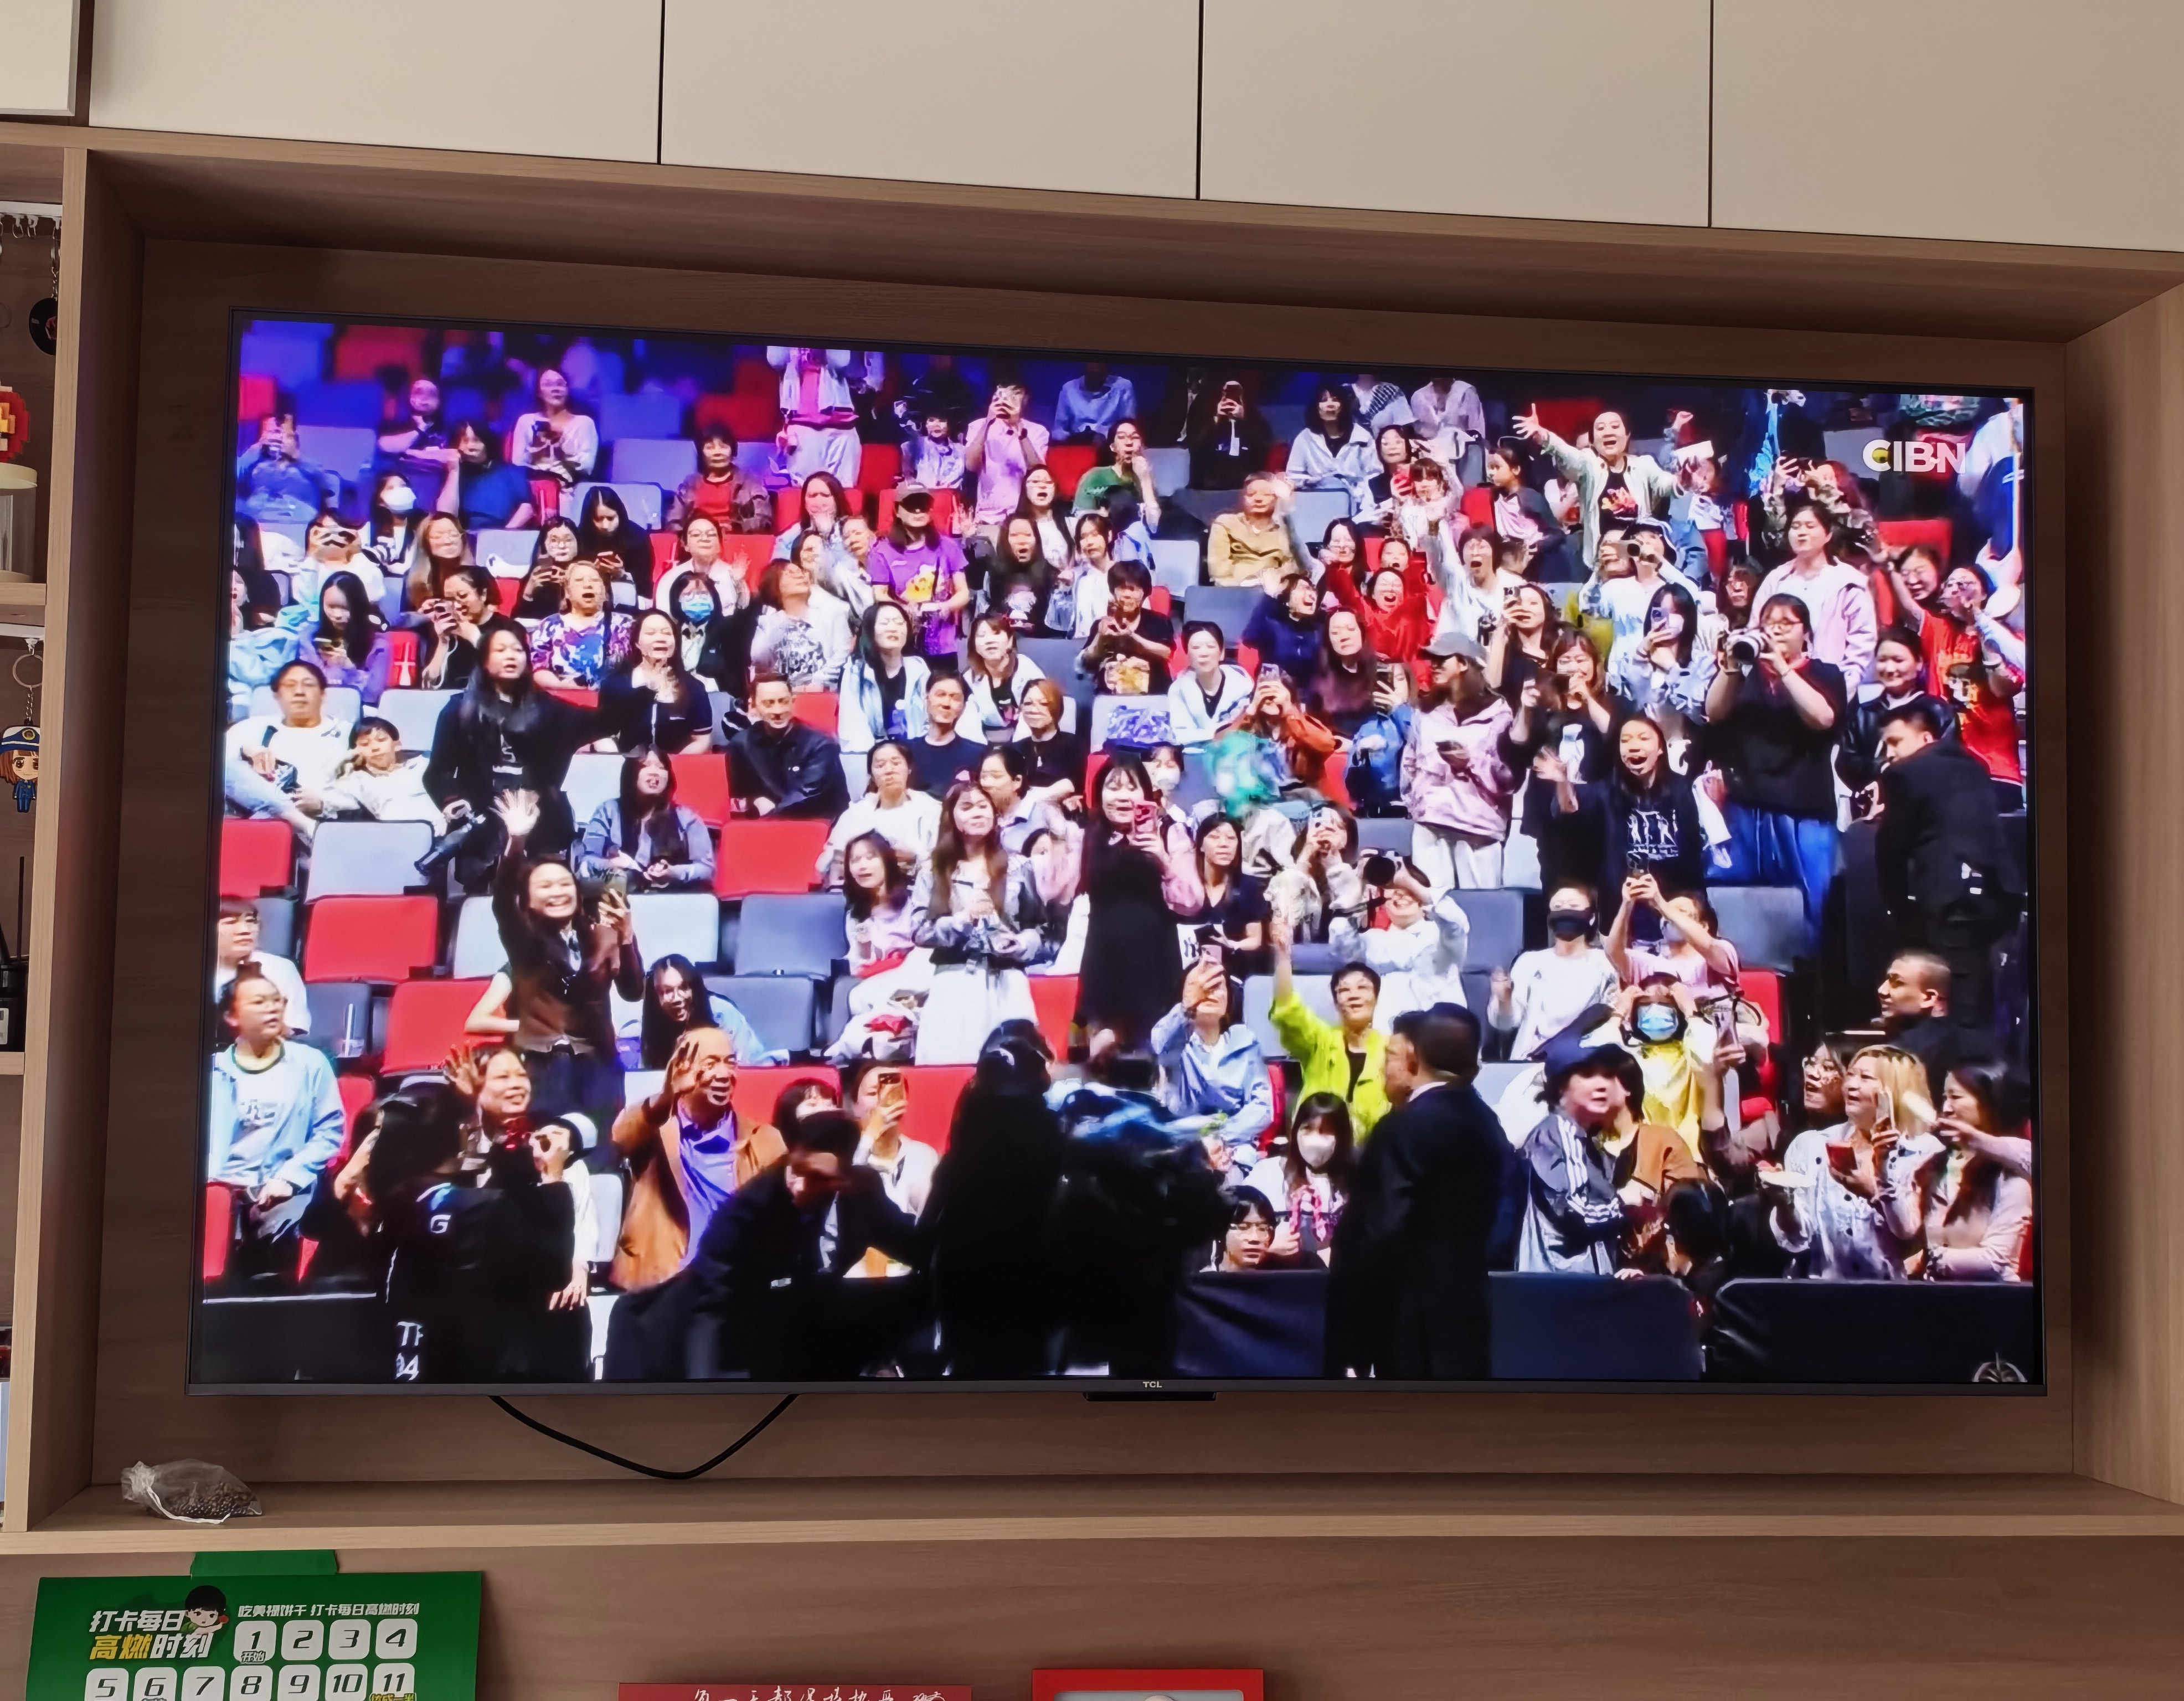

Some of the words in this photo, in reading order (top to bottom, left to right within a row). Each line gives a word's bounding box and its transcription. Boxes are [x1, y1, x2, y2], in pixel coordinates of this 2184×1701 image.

[1862, 439, 1966, 474] CIBN
[89, 1610, 187, 1632] 打卡每日
[90, 1633, 214, 1659] 高燃时刻
[251, 1631, 261, 1650] 1
[293, 1630, 313, 1649] 2
[339, 1630, 360, 1648] 3
[385, 1628, 406, 1647] 4
[95, 1678, 118, 1698] 5
[144, 1677, 167, 1697] 6
[195, 1677, 215, 1695] 7
[241, 1676, 262, 1694] 8
[288, 1675, 310, 1694] 9
[333, 1674, 363, 1693] 10
[384, 1673, 405, 1692] 11
